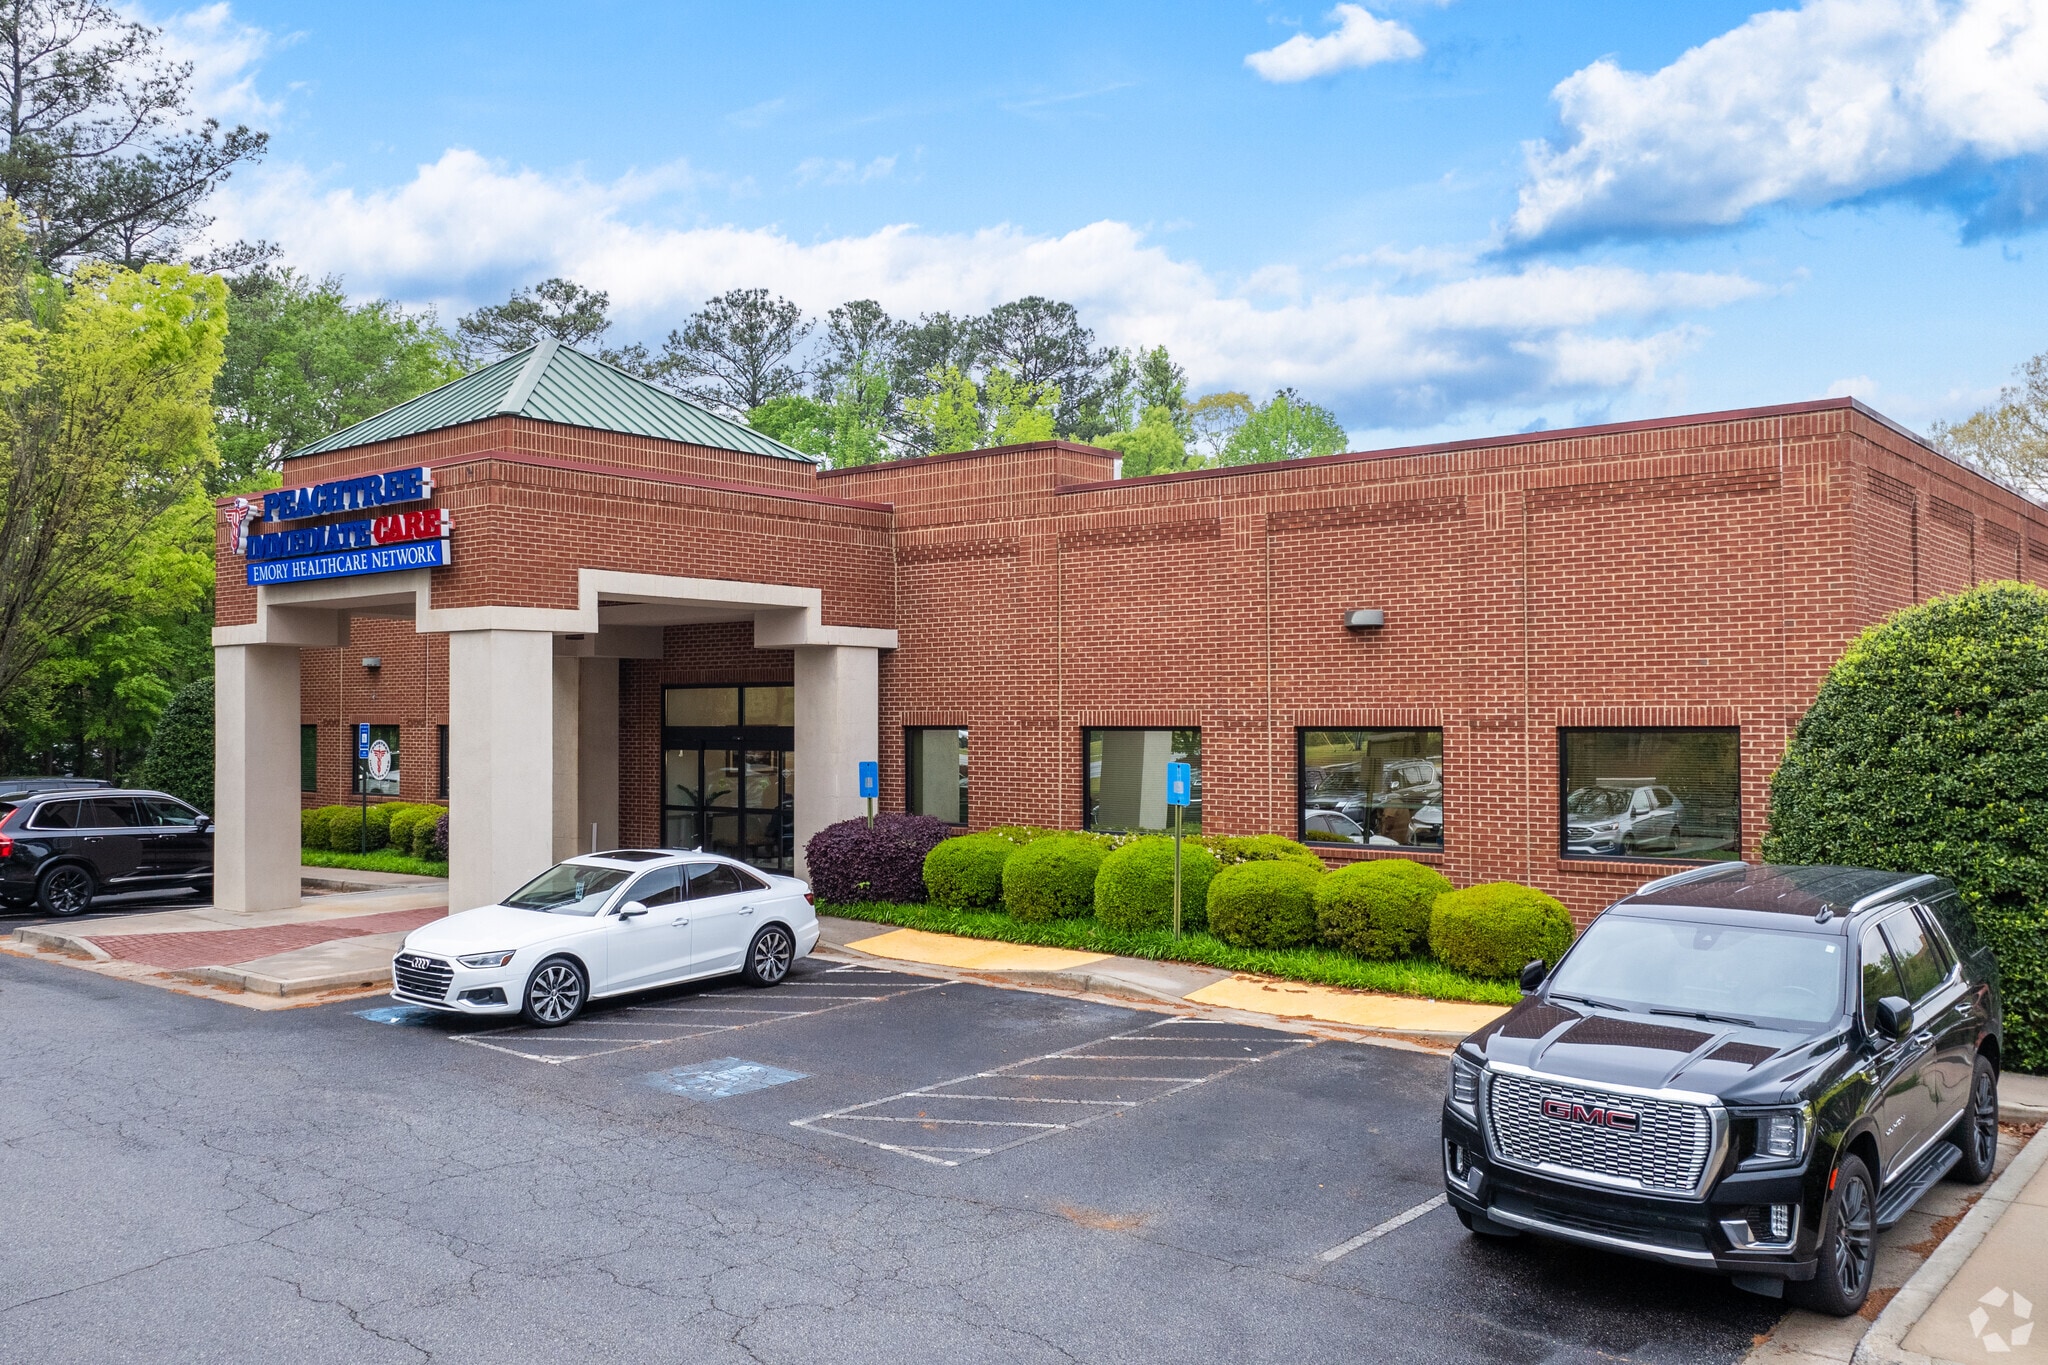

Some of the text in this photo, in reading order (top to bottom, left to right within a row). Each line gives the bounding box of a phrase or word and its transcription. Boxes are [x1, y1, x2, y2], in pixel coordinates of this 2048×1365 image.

[263, 467, 424, 522] PEACHTREE
[247, 509, 442, 560] IMMEDIATE CARE
[253, 544, 437, 582] EMORY HEALTHCARE NETWORK
[1543, 1099, 1637, 1132] GMC
